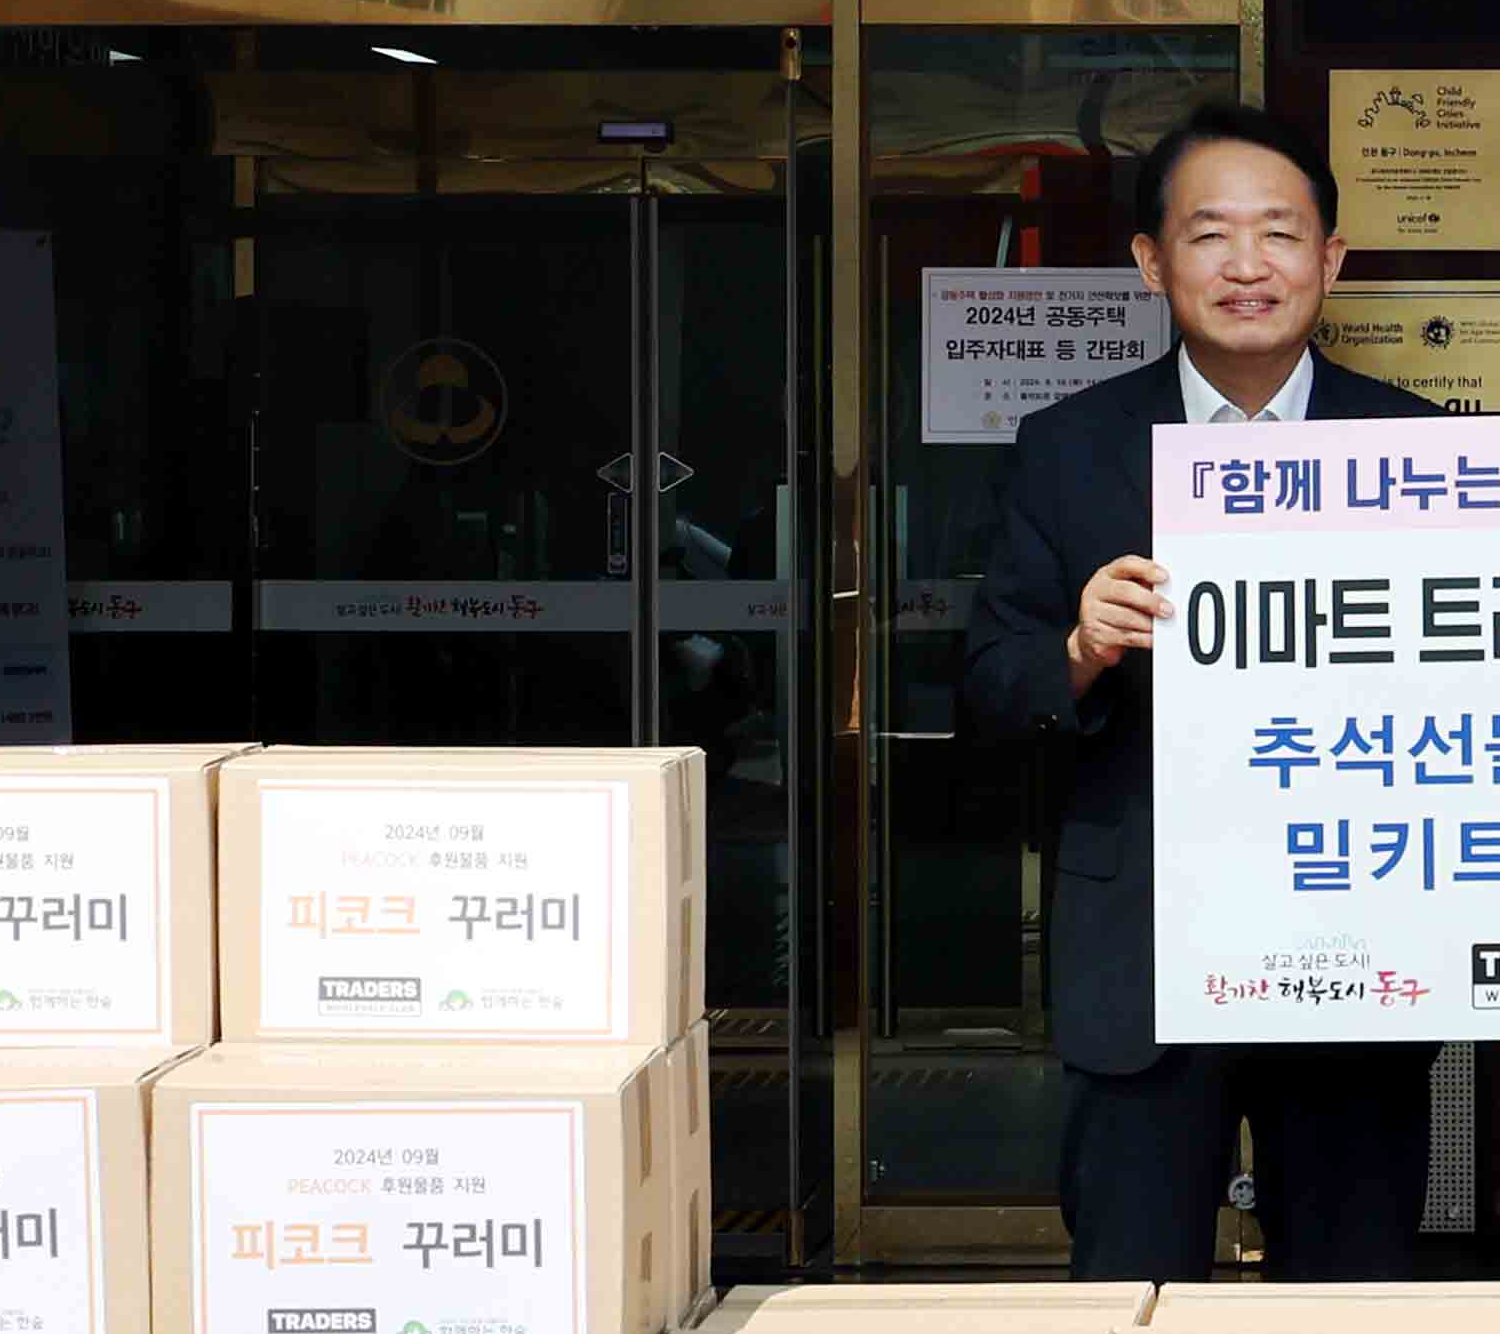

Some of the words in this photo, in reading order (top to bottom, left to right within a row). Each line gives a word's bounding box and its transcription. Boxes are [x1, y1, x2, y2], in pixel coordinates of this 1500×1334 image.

[1396, 213, 1428, 224] unicef
[965, 306, 1036, 327] 2024년
[1045, 306, 1127, 328] 공동주택
[1341, 322, 1370, 333] World
[1372, 322, 1404, 333] Health
[1341, 334, 1404, 347] Organization
[946, 339, 1045, 361] 입주자대표
[1055, 339, 1076, 361] 등
[1086, 339, 1145, 361] 간담회
[1412, 376, 1455, 390] certify
[1457, 376, 1483, 388] that
[1187, 578, 1395, 670] 이마트
[1204, 974, 1270, 1006] 활기찬
[1277, 975, 1365, 1006] 행복도시
[1369, 970, 1431, 1007] 동구
